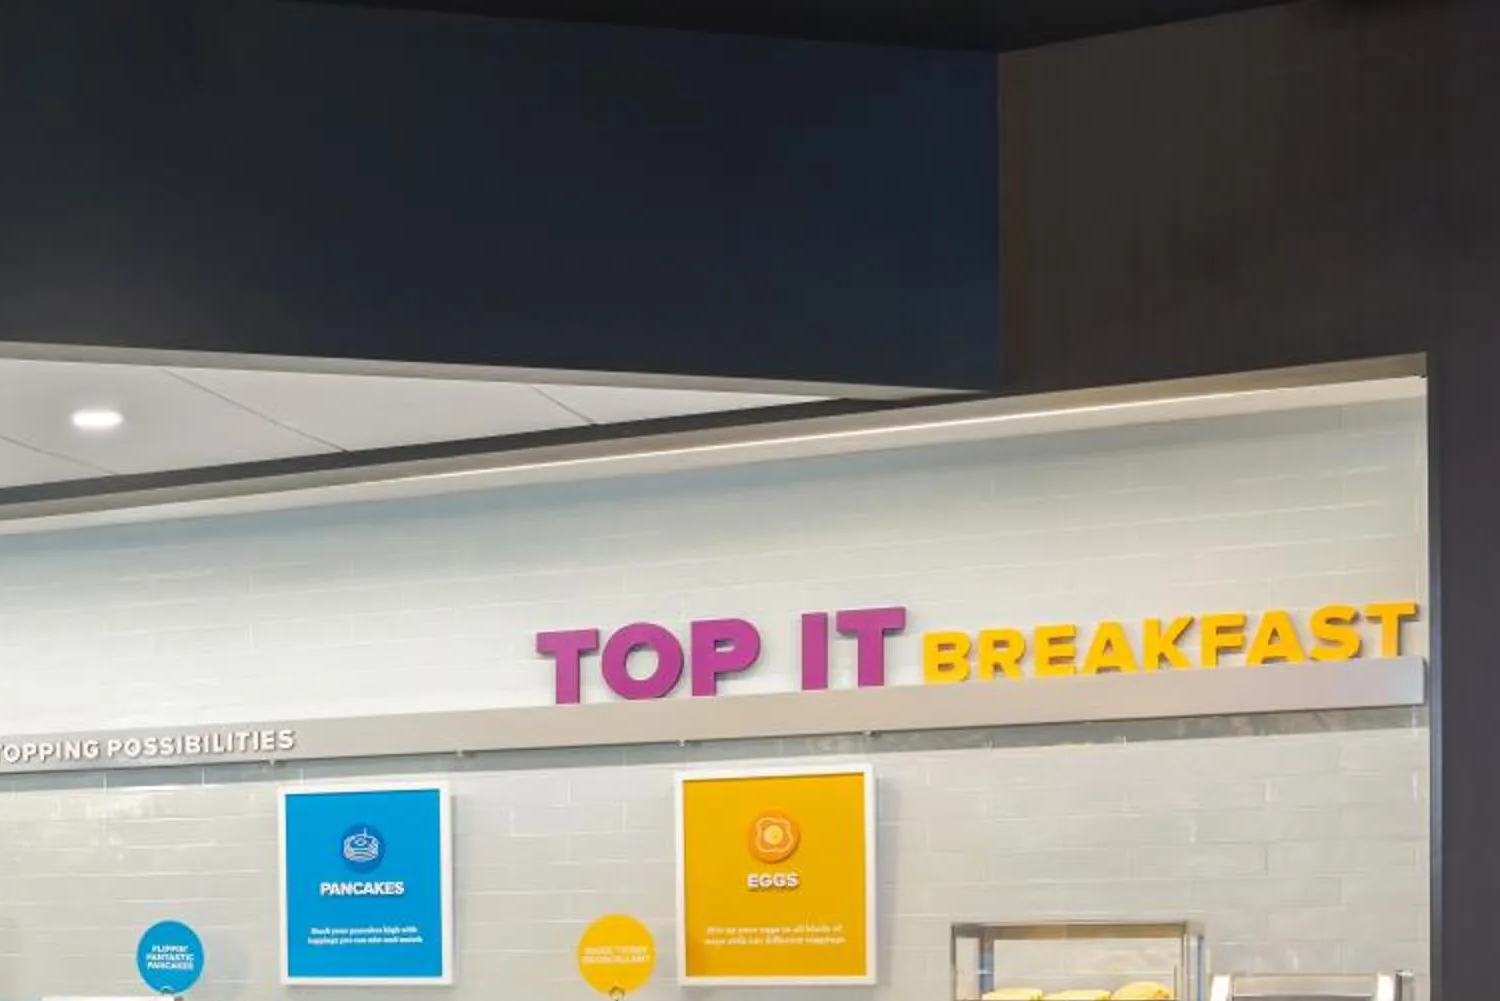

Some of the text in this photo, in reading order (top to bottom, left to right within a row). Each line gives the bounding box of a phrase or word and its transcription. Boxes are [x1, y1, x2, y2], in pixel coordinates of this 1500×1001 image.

[536, 602, 1418, 704] TOP IT BREAKFAST
[106, 729, 296, 757] POSSIBILITIES
[320, 881, 404, 896] PANCAKES
[747, 872, 800, 888] EGGS
